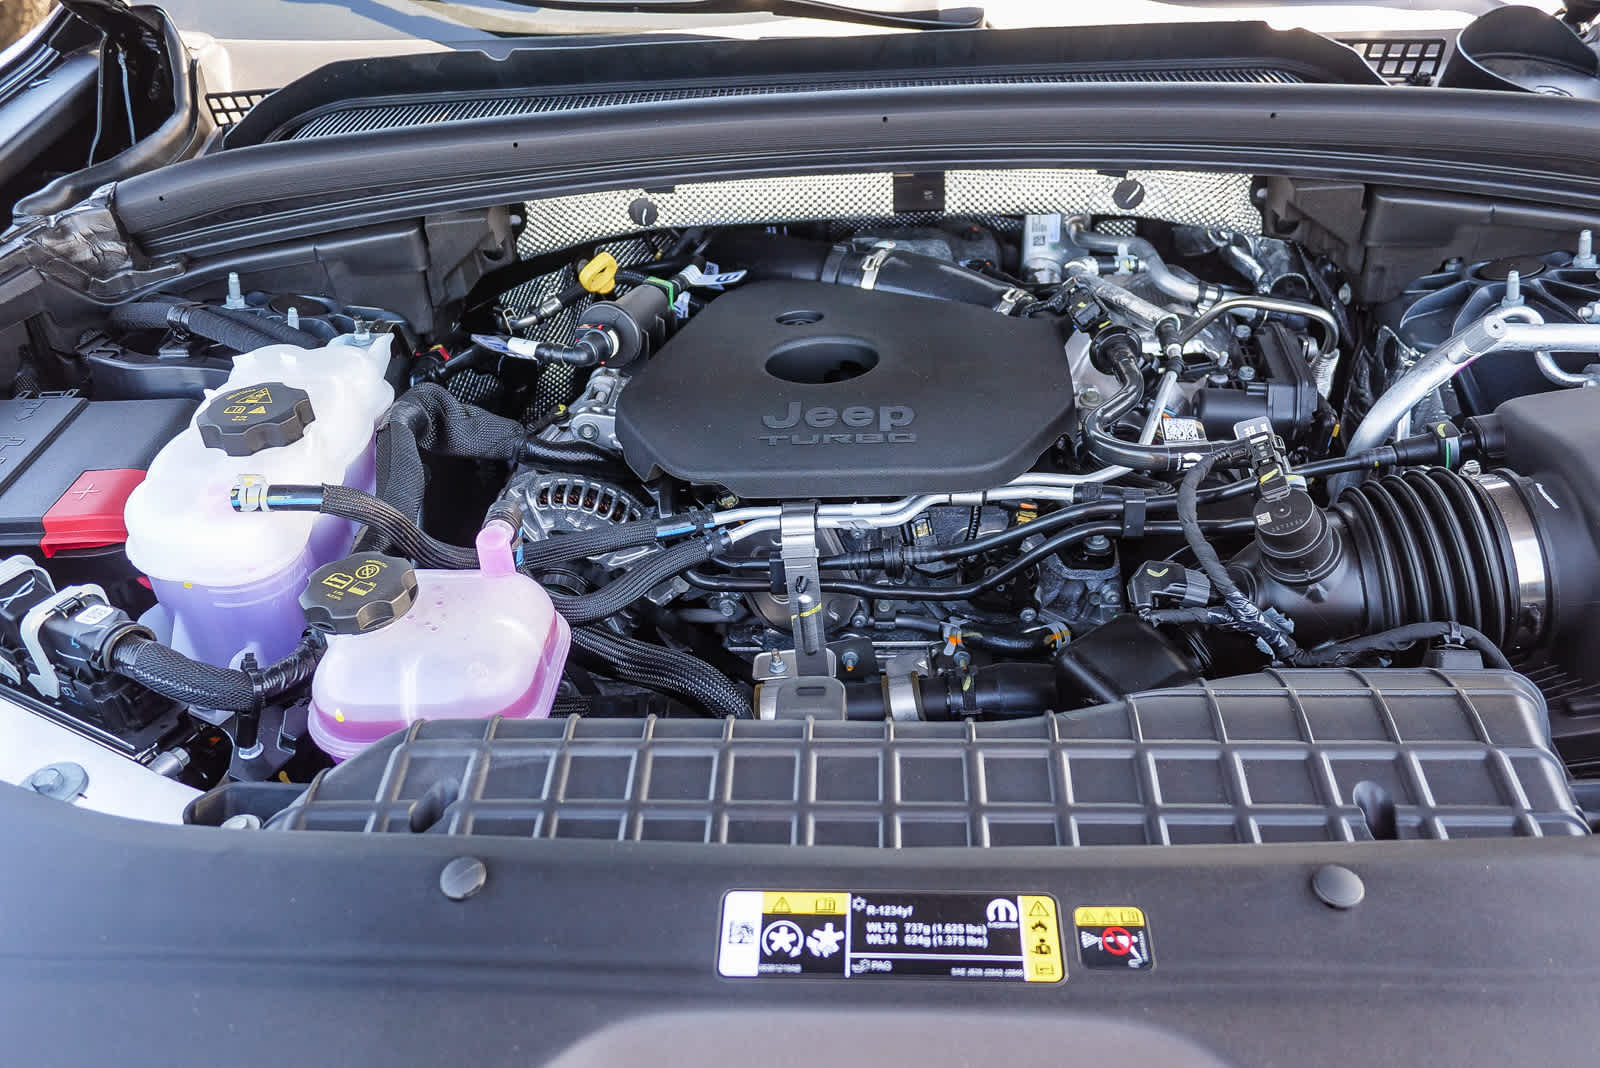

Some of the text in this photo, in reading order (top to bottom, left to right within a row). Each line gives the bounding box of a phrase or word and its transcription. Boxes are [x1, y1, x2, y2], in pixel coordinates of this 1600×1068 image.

[762, 402, 915, 431] Jeep
[759, 433, 917, 446] TURBO
[866, 922, 897, 933] WL75
[904, 923, 931, 935] 737g
[866, 934, 897, 944] WL74
[932, 934, 965, 947] (1.375
